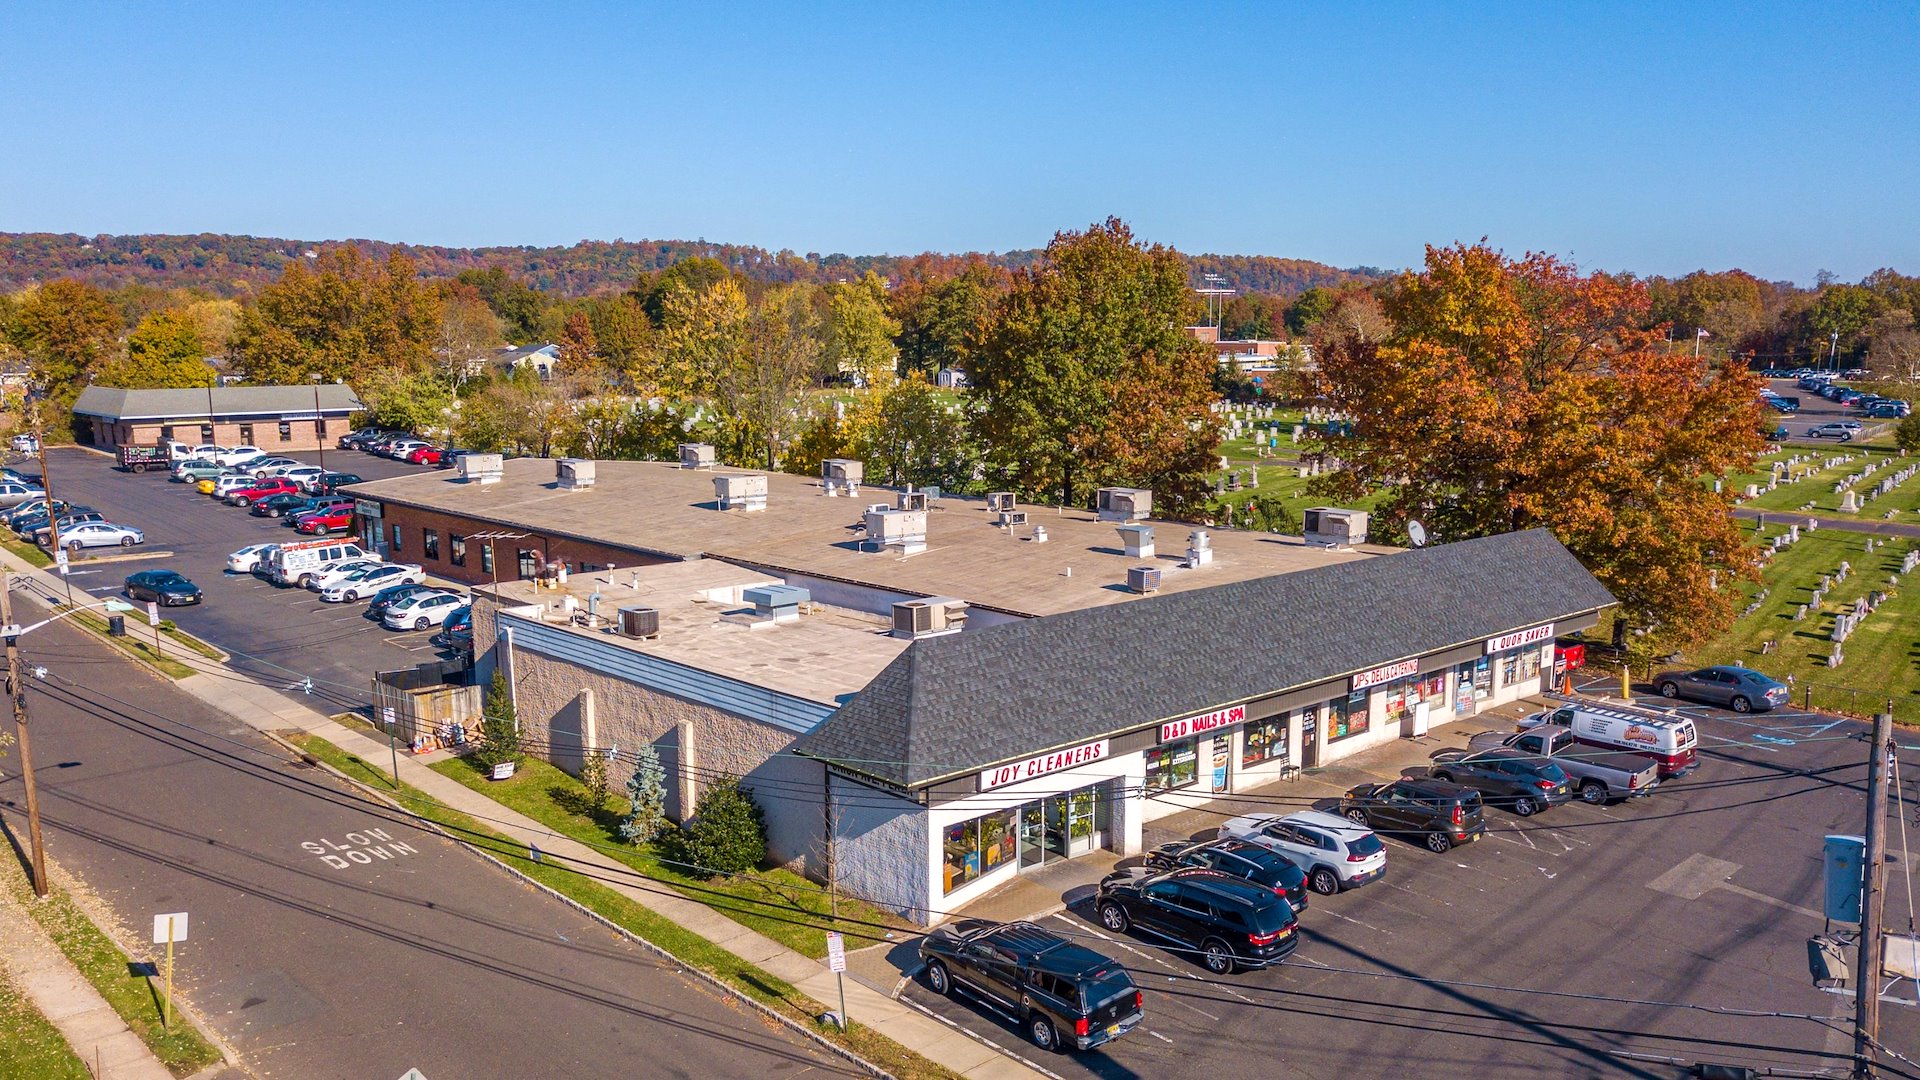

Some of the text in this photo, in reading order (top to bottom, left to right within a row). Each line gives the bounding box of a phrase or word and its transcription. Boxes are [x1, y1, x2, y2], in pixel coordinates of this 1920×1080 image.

[1525, 626, 1550, 642] SAVER
[1192, 713, 1217, 733] NAILS
[1220, 711, 1226, 726] &
[1228, 707, 1244, 723] SPA
[991, 743, 1101, 786] JOY CLEANERS
[300, 827, 394, 855] SLOW
[319, 841, 419, 870] DOWN
